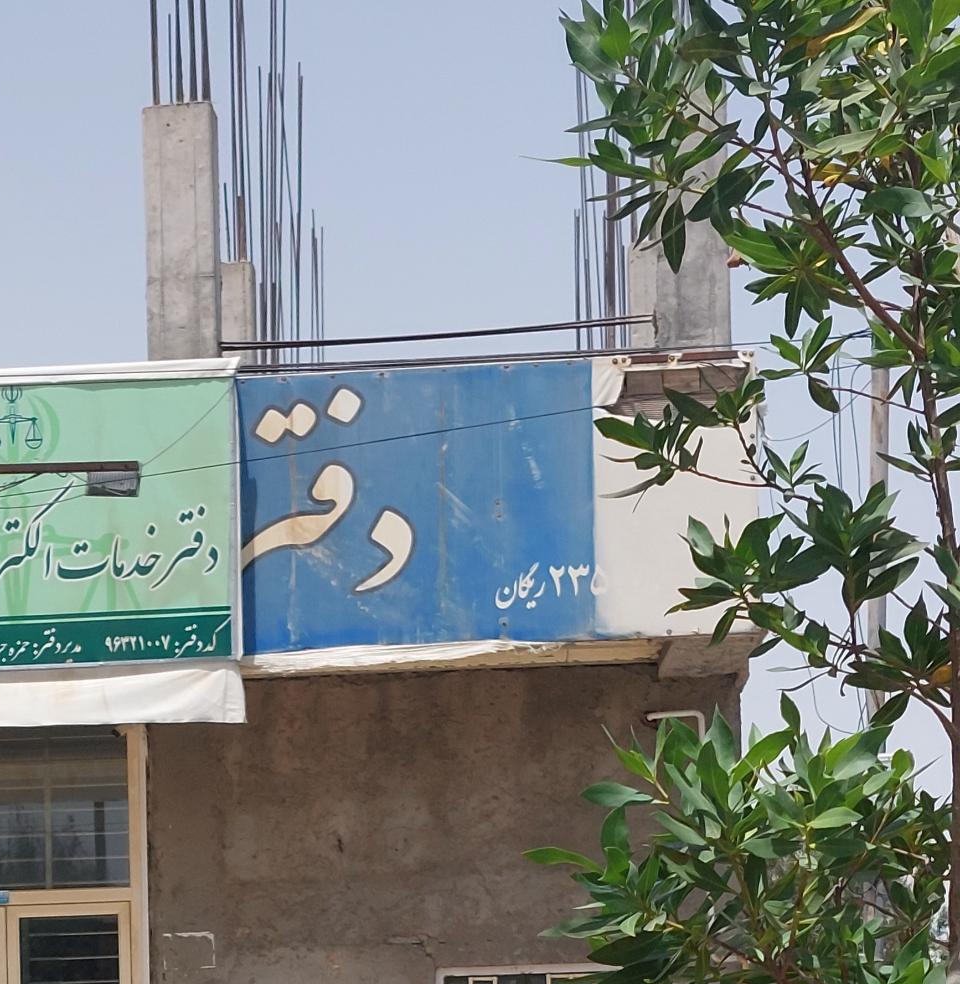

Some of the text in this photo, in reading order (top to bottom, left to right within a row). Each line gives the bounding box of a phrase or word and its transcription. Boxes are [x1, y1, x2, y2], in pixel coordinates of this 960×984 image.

[56, 523, 163, 581] خدمات
[151, 504, 219, 590] دفتر
[495, 562, 546, 609] ریگان
[10, 640, 31, 662] حمزه
